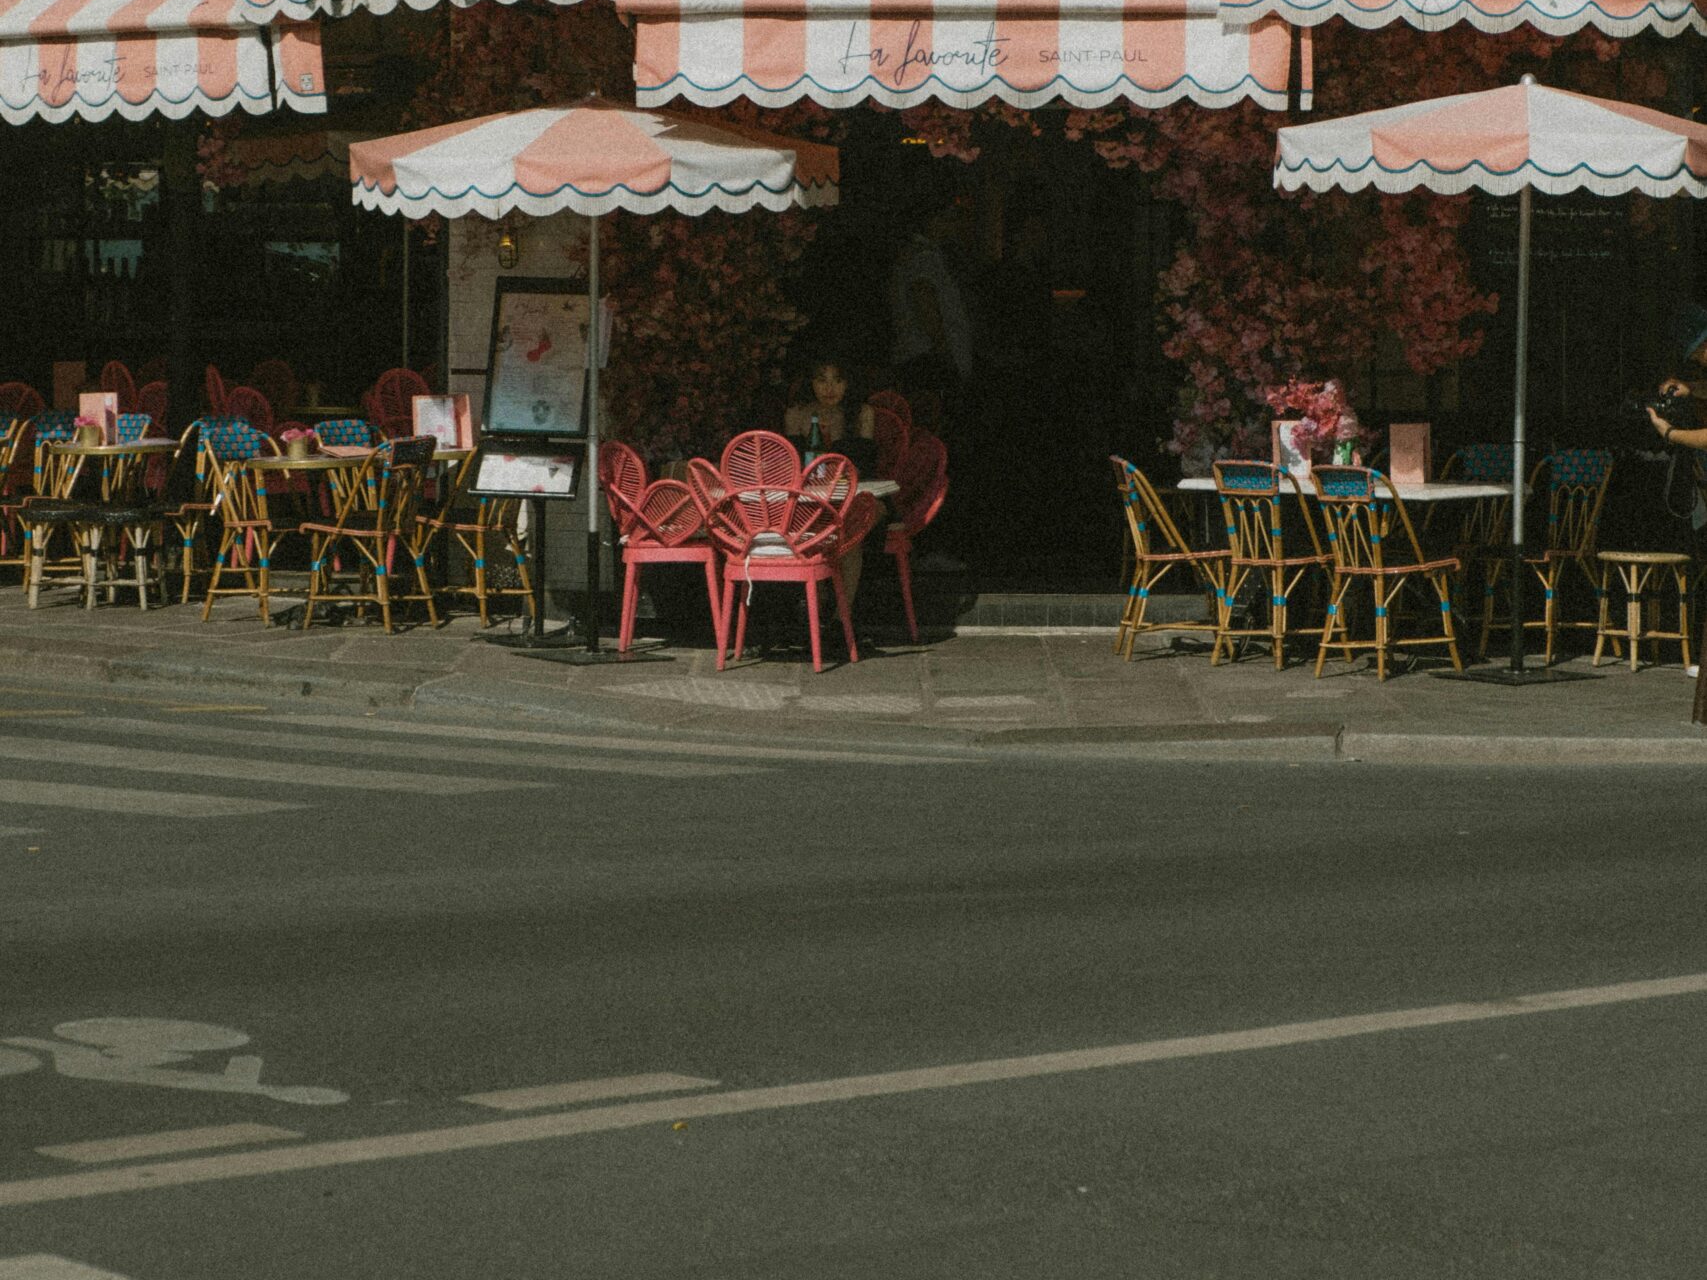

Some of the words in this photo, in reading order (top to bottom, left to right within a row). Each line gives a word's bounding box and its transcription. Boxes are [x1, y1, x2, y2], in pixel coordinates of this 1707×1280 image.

[20, 47, 51, 92] La
[51, 42, 127, 103] favorite
[839, 21, 889, 74] La
[894, 19, 1011, 86] favorite
